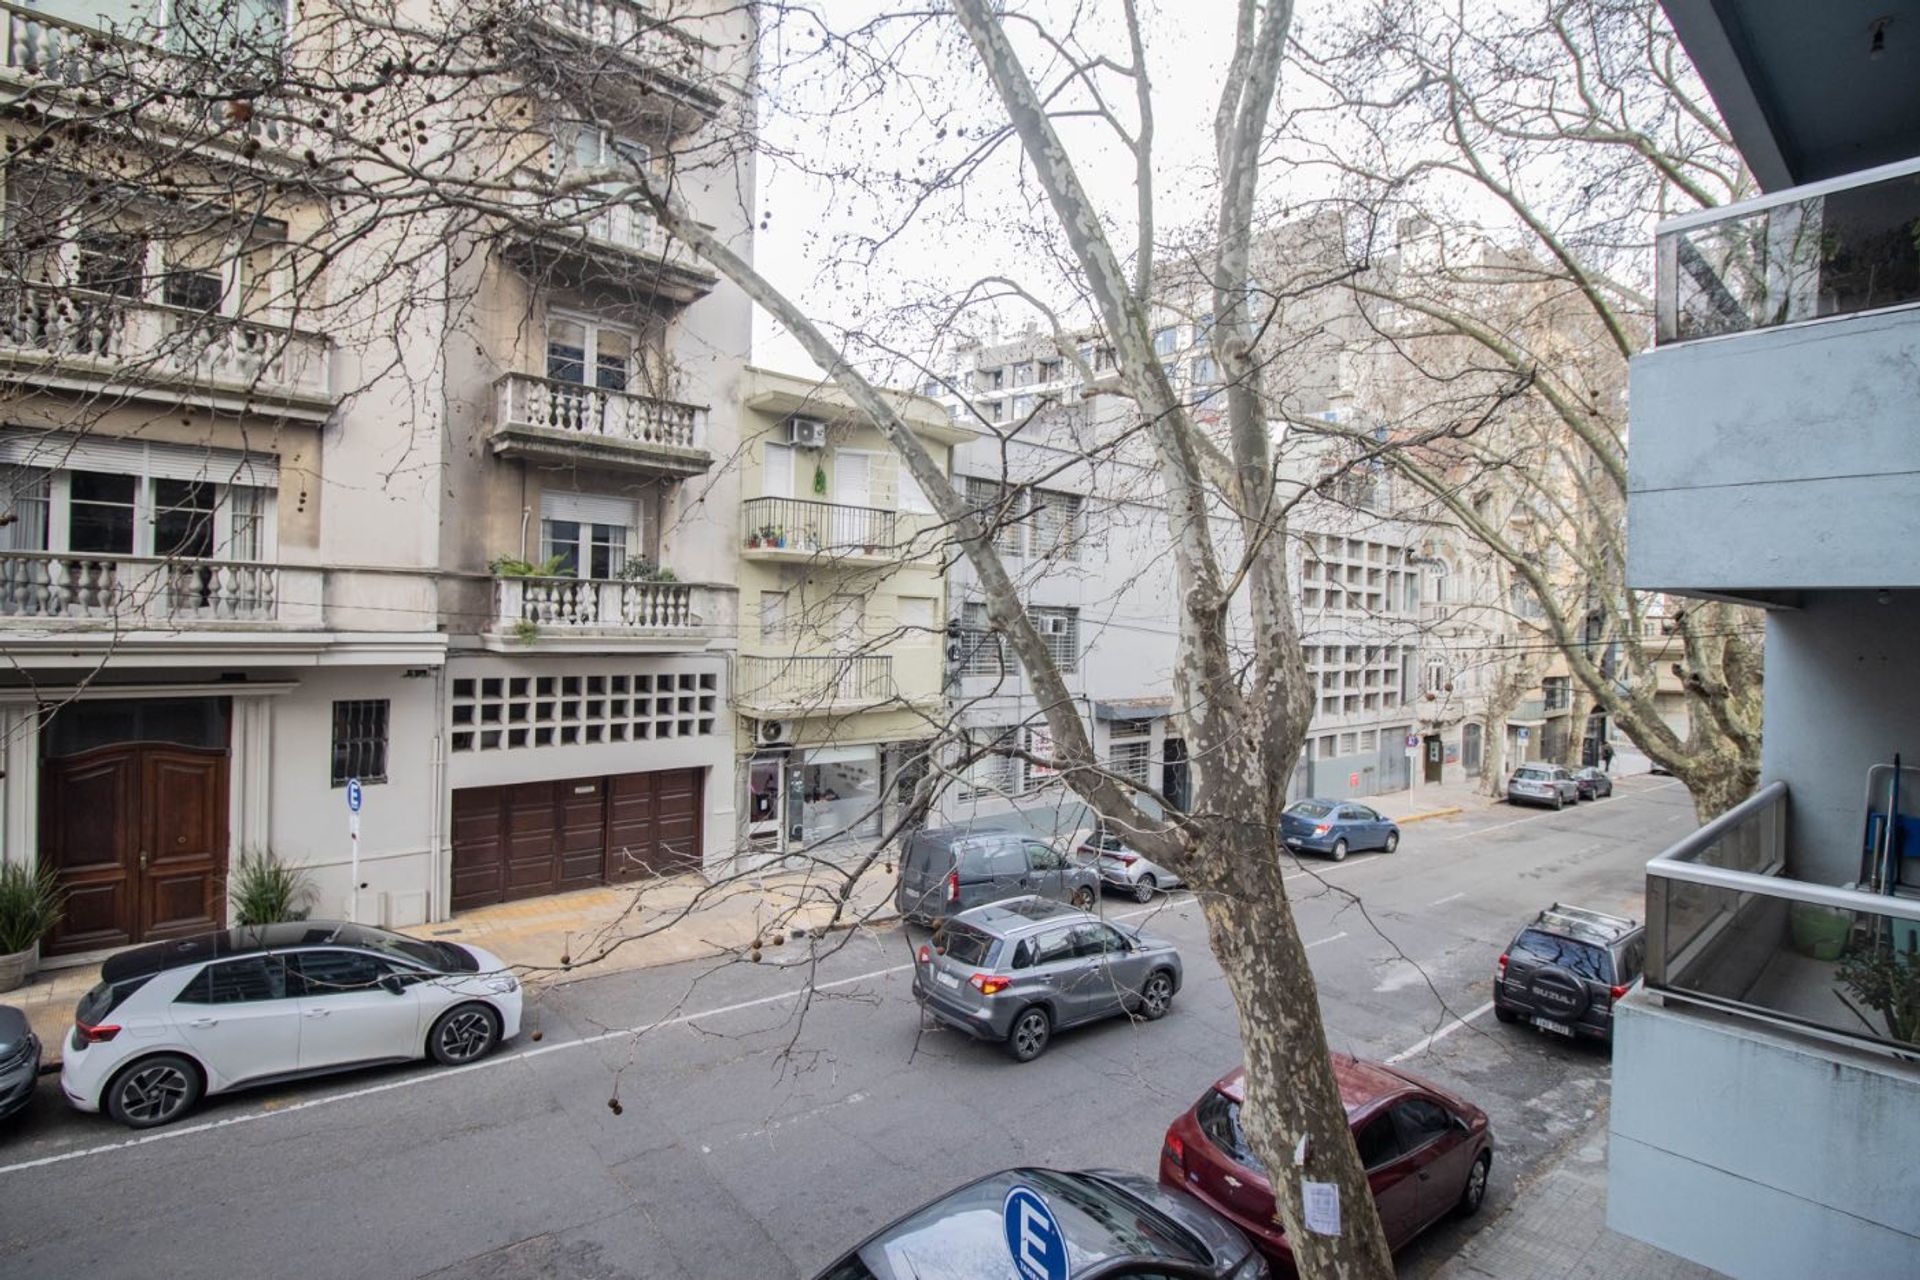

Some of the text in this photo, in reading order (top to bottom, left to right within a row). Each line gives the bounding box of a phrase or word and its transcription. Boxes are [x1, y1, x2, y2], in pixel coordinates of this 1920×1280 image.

[351, 783, 359, 804] E
[1532, 985, 1577, 1006] SUZUKI
[1020, 1198, 1049, 1280] E
